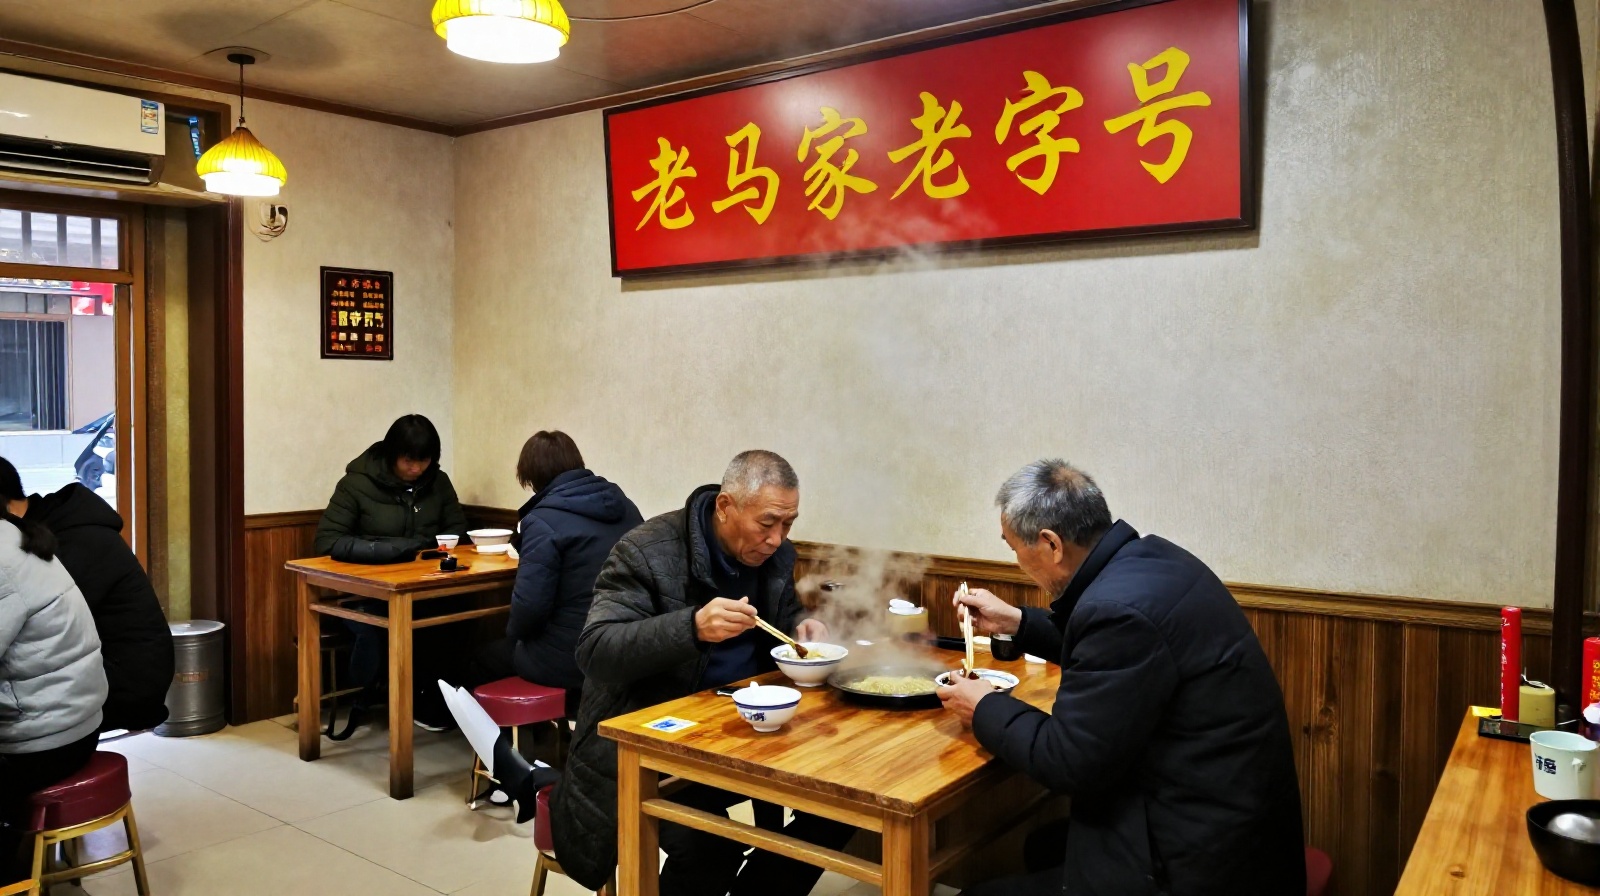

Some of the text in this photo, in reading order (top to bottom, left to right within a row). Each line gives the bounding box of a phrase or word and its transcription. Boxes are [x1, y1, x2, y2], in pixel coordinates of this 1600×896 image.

[632, 46, 1212, 231] 老马家老字号
